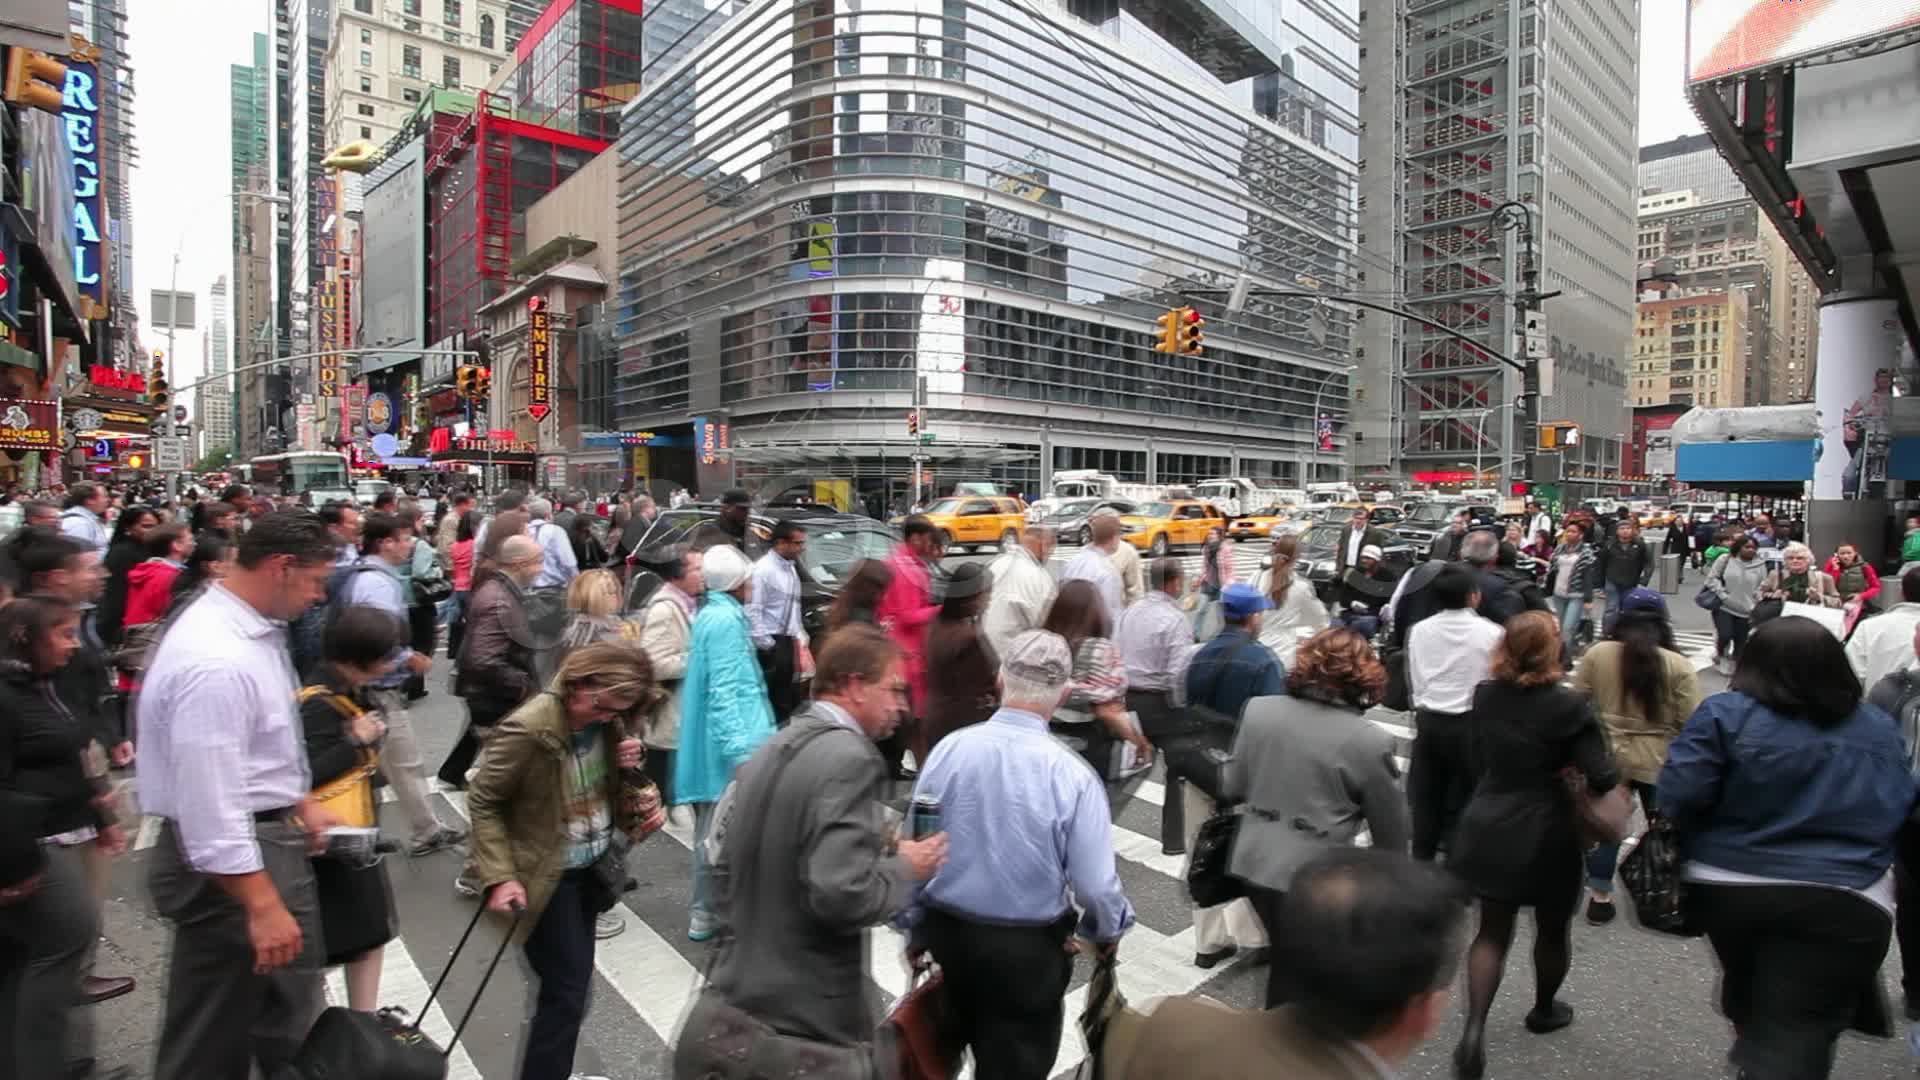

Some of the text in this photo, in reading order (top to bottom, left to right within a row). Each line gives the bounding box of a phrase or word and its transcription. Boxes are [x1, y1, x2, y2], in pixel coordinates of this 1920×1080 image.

[61, 69, 101, 286] REGAL
[319, 280, 337, 396] TUSSAUDS
[534, 314, 547, 402] EMPIRE
[0, 430, 51, 439] RUMBS
